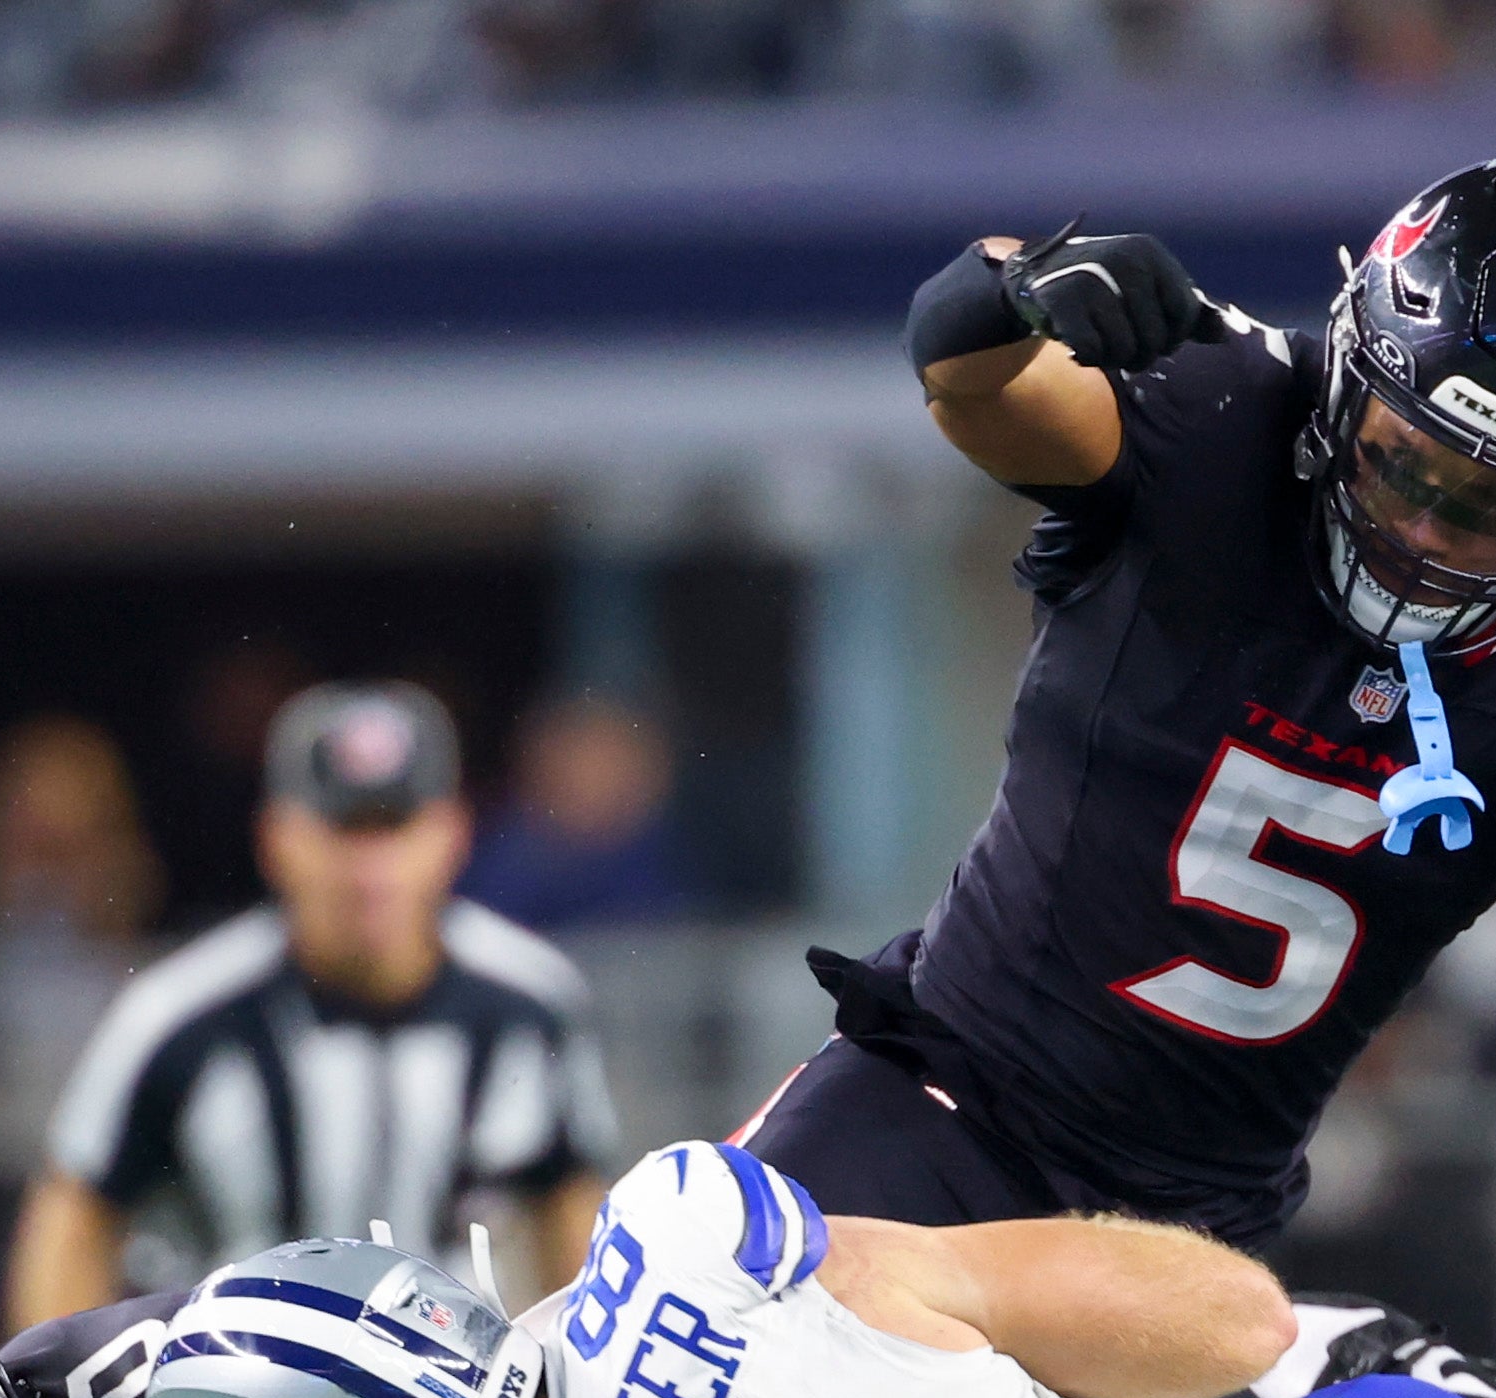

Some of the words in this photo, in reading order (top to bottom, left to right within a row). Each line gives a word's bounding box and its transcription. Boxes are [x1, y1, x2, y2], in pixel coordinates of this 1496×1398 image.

[1243, 700, 1407, 778] TEXAN
[1356, 686, 1389, 716] NFL
[1110, 736, 1389, 1047] 5
